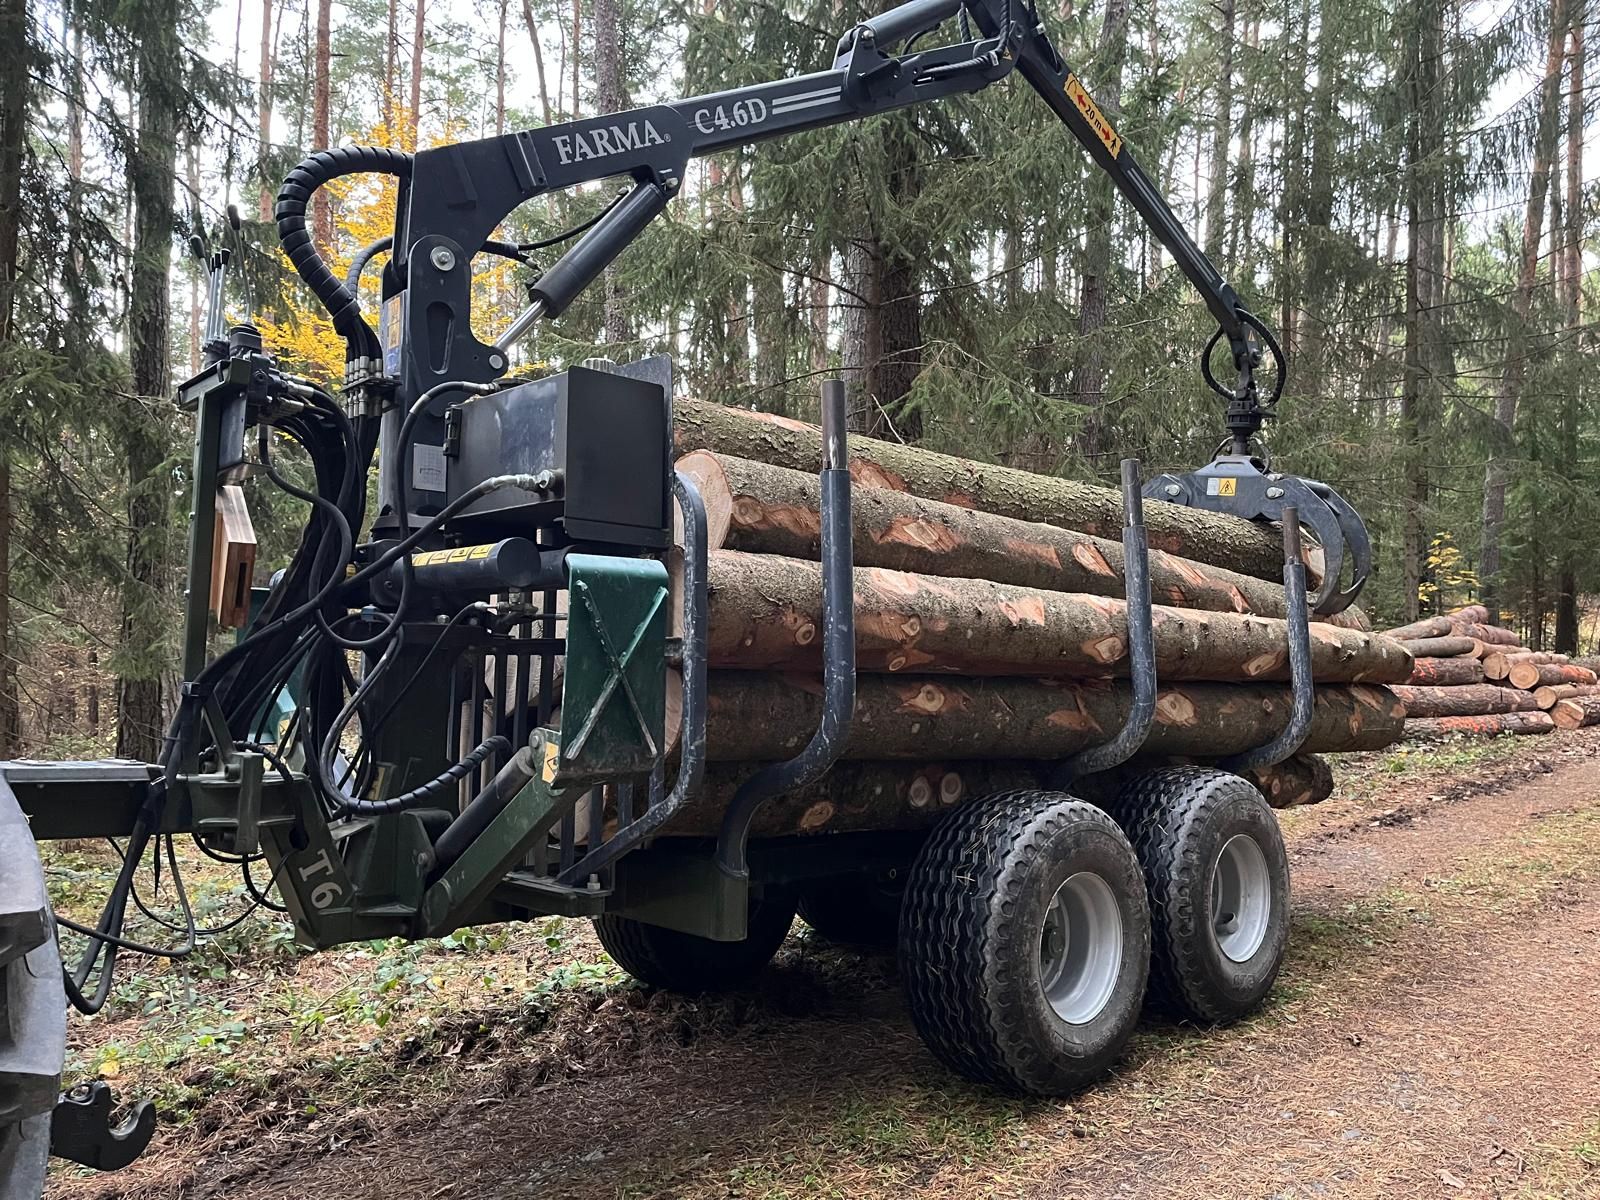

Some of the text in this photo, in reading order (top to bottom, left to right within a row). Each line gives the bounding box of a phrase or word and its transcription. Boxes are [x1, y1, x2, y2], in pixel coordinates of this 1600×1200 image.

[694, 98, 767, 134] C4.6D
[1085, 104, 1102, 131] 20 m
[298, 848, 343, 909] T6
